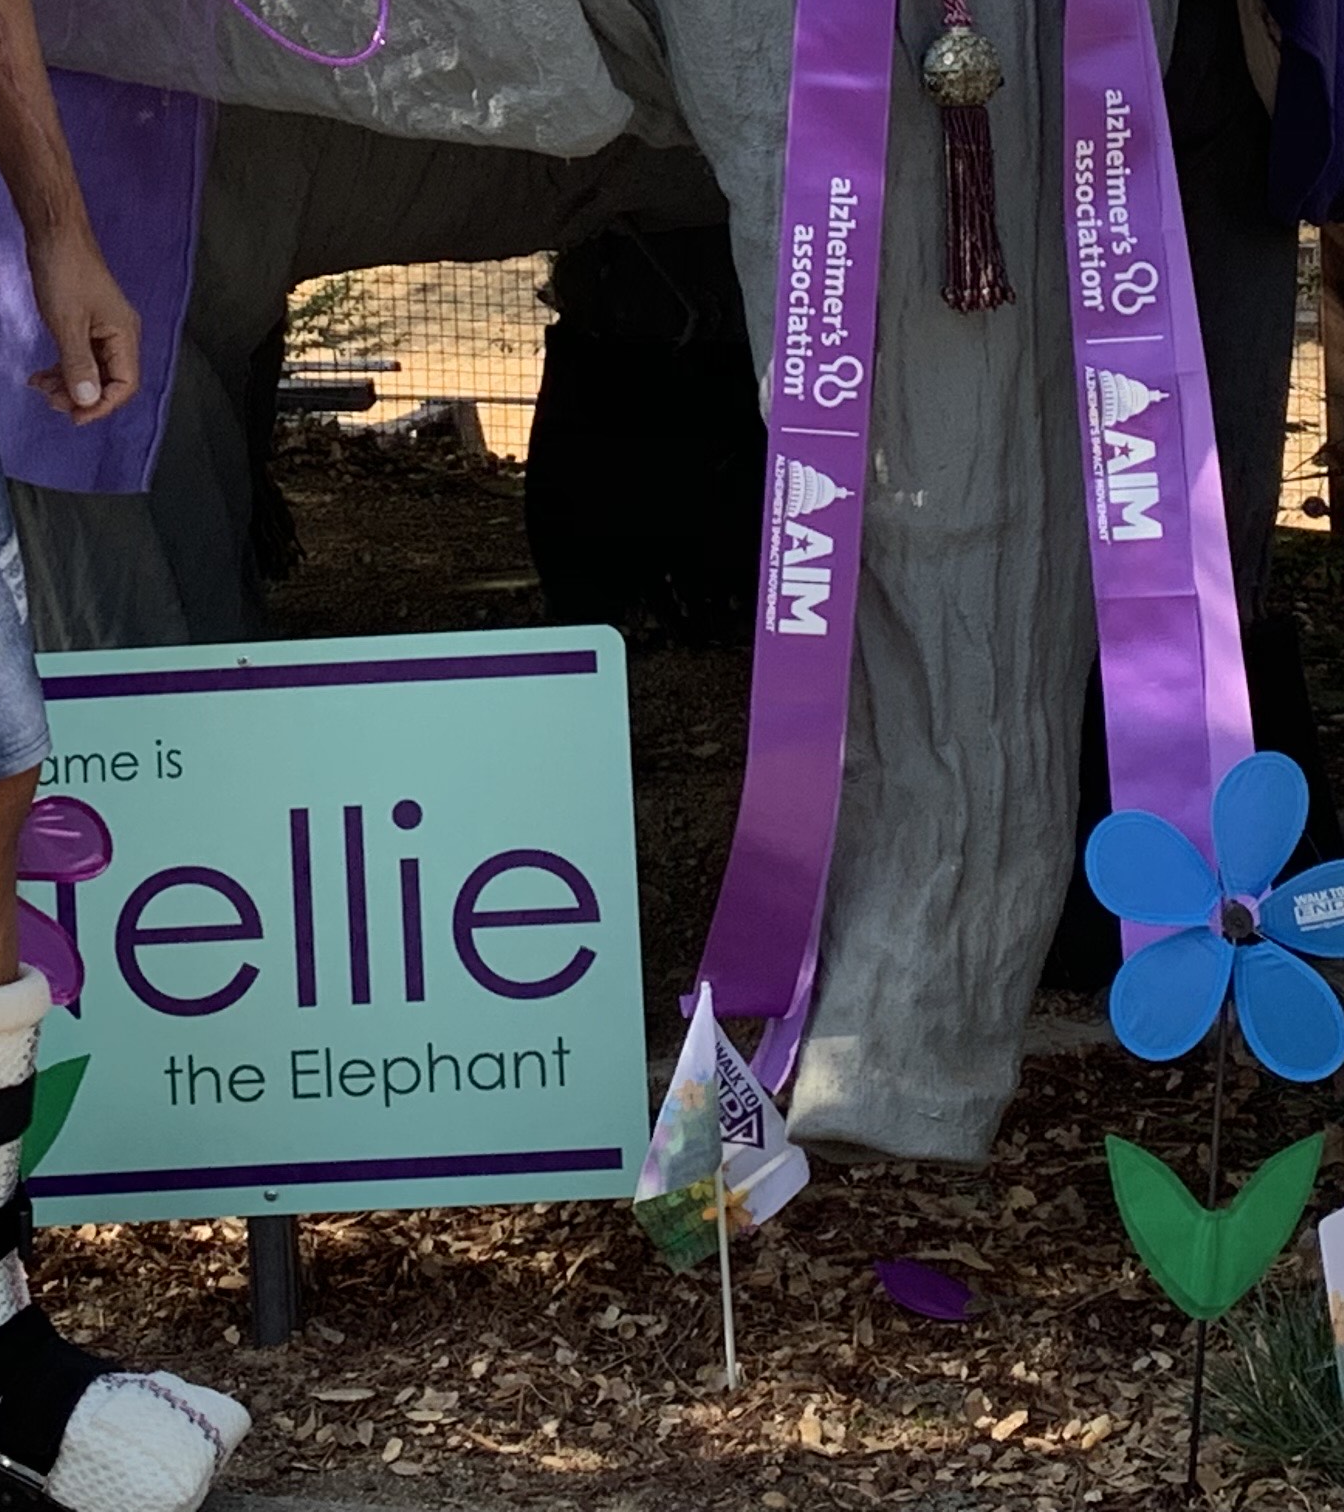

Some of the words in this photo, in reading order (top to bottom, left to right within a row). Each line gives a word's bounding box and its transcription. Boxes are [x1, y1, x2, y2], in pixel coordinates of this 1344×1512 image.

[1075, 139, 1105, 311] association
[1105, 88, 1132, 256] alzheimer's
[783, 223, 814, 398] association
[820, 177, 859, 347] alzheimer's
[1103, 429, 1164, 541] AIM
[778, 519, 834, 636] AIM
[156, 739, 184, 780] is
[55, 799, 601, 1020] ellie
[164, 1054, 266, 1106] the
[291, 1036, 571, 1108] Elephant
[739, 1082, 760, 1107] TO
